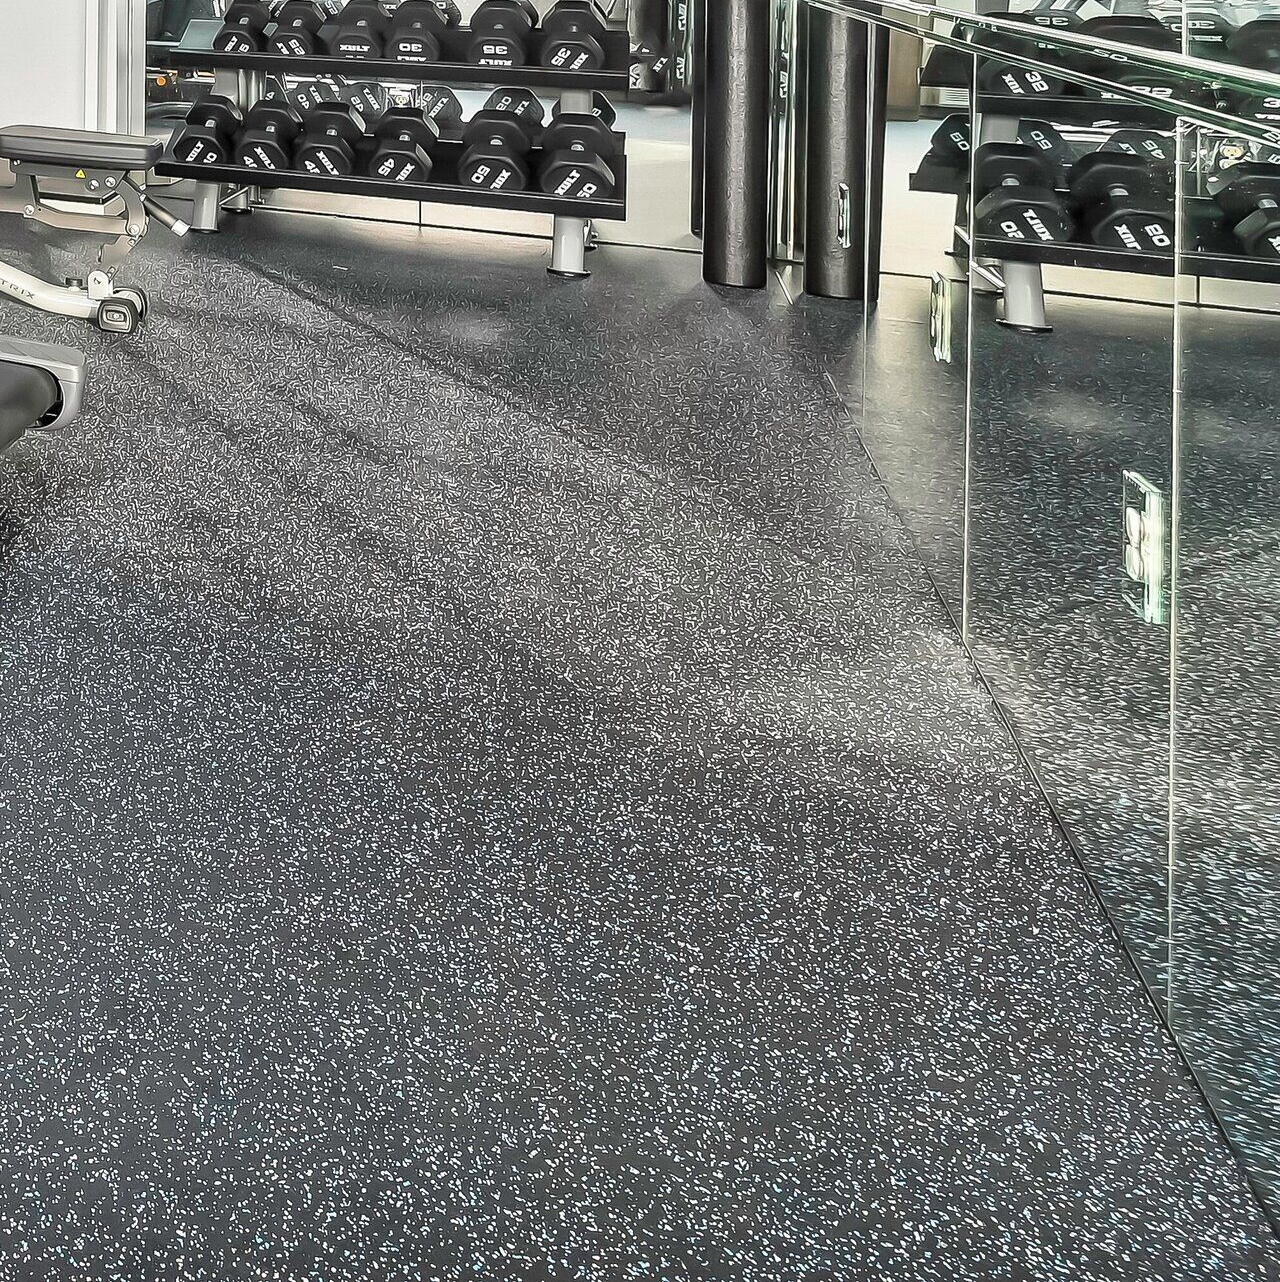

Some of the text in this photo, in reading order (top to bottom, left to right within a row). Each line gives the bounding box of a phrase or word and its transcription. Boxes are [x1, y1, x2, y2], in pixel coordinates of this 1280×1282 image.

[288, 39, 306, 56] 25
[339, 44, 371, 53] XULT
[398, 43, 423, 53] 30
[482, 45, 508, 55] 35
[550, 47, 571, 67] 35
[570, 52, 589, 70] XUL
[253, 146, 276, 170] XULT
[315, 150, 340, 176] XULT
[377, 158, 395, 177] 45
[395, 162, 416, 182] XUL
[489, 168, 512, 191] XUL
[553, 169, 582, 196] XULT
